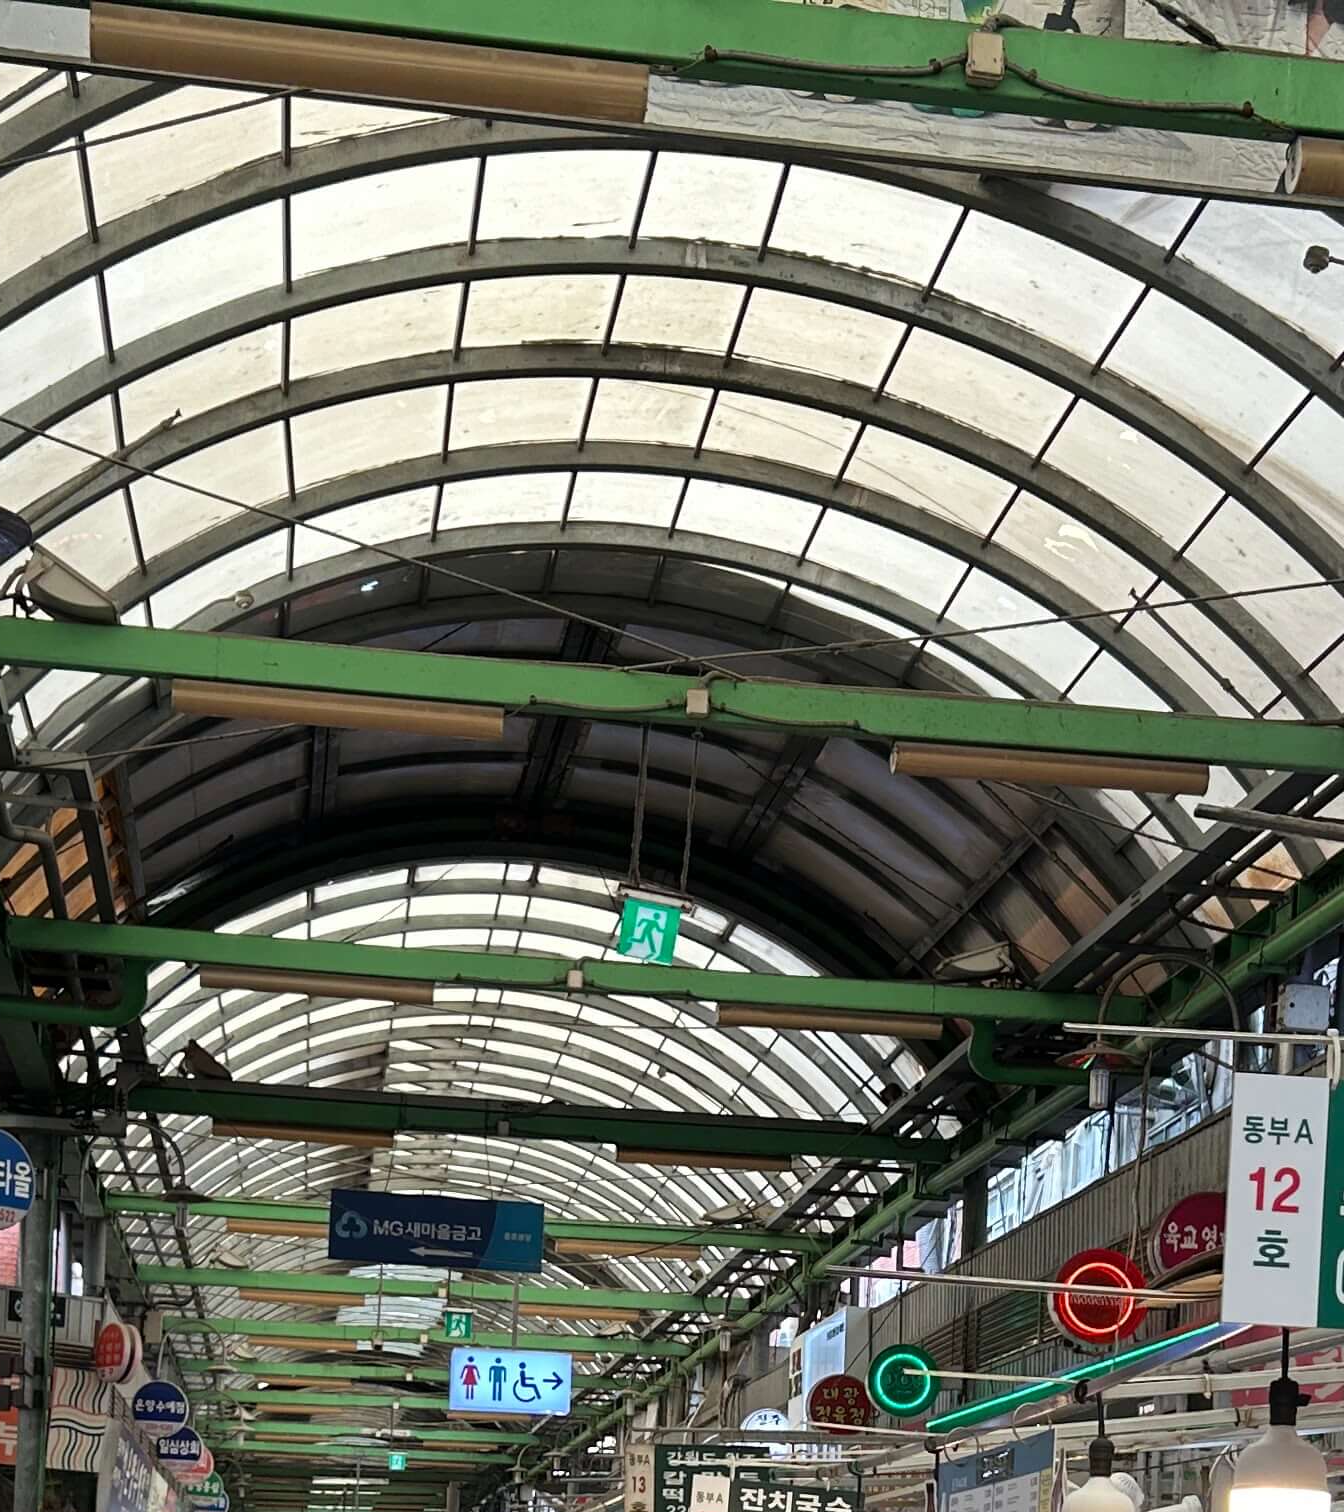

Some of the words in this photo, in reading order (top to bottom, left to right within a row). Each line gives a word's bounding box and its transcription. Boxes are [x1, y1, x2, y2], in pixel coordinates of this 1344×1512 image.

[1247, 1166, 1301, 1214] 12
[373, 1219, 483, 1242] MG새마을금고
[1163, 1221, 1225, 1253] 육교영
[1252, 1229, 1291, 1270] 호
[822, 1386, 860, 1405] 대광
[815, 1404, 865, 1426] 정육점
[631, 1475, 647, 1494] 13
[696, 1491, 724, 1505] 동부A
